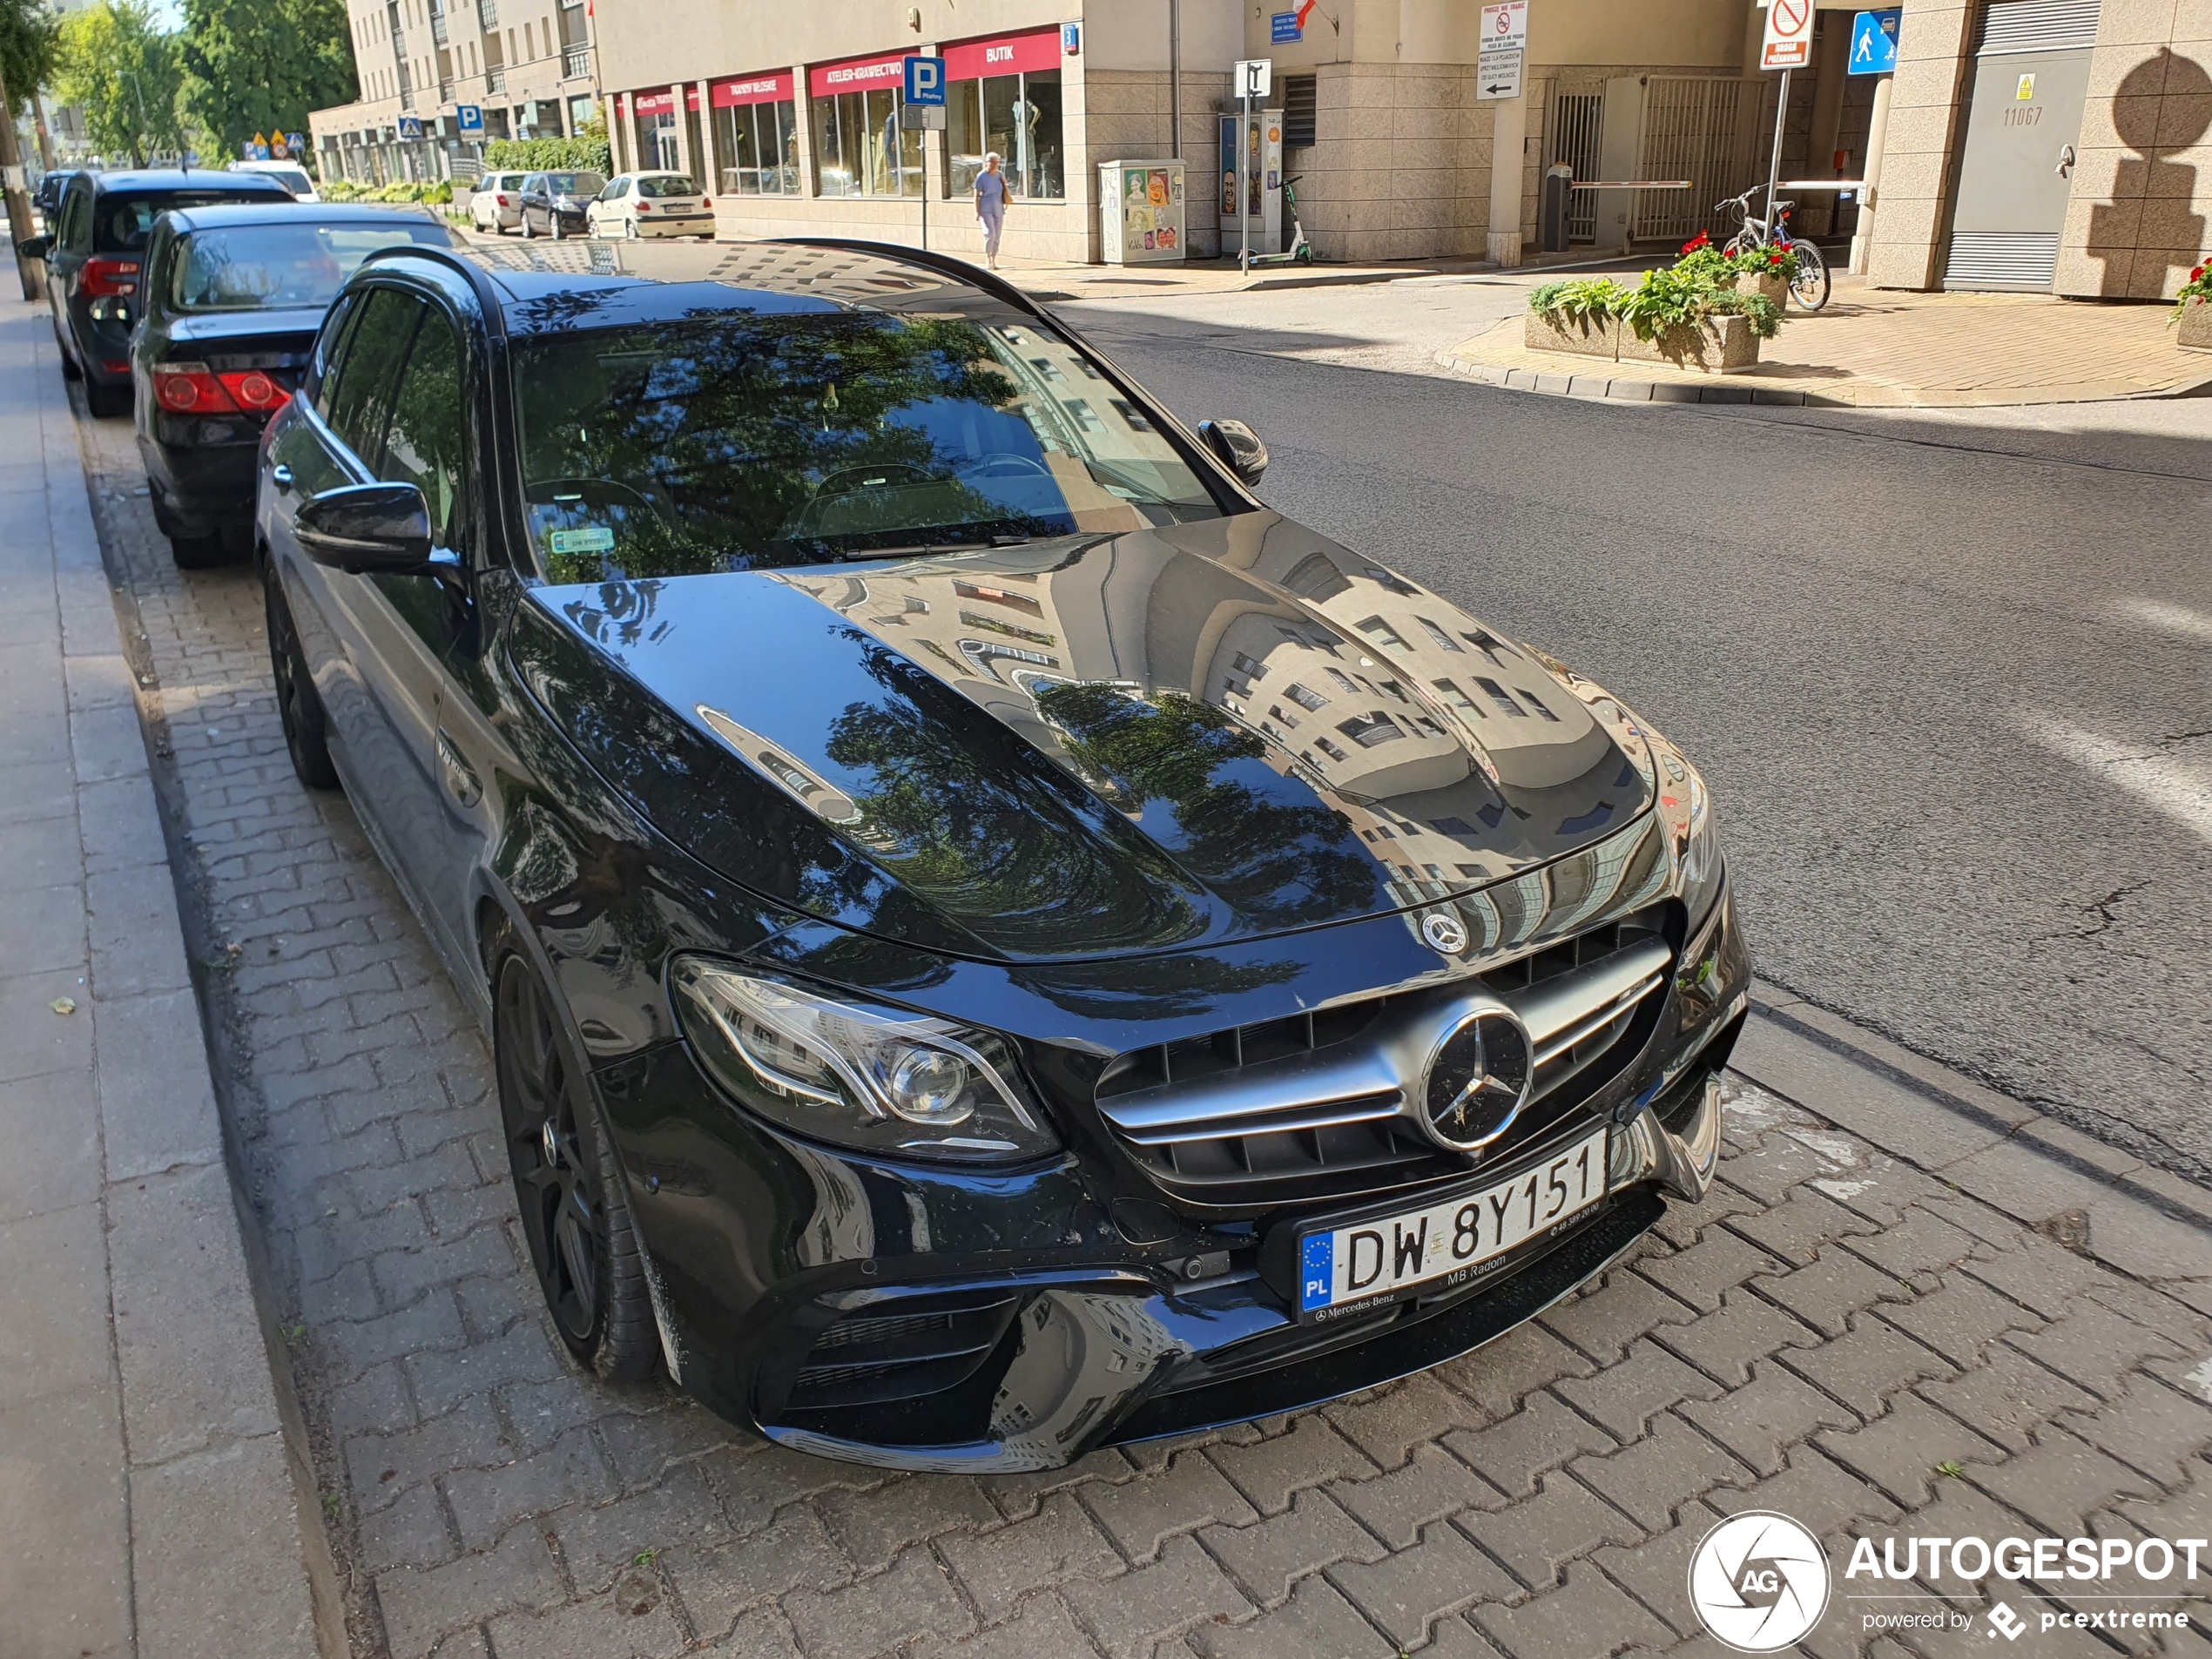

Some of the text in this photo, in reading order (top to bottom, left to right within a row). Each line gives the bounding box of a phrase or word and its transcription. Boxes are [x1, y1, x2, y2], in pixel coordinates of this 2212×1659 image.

[1066, 30, 1071, 45] 3
[1775, 42, 1797, 52] DROGA
[986, 45, 1014, 63] BUTIK
[1767, 52, 1802, 64] POŻAROWA
[914, 62, 937, 99] P
[462, 107, 477, 127] P
[2004, 106, 2043, 126] 11067
[1347, 1144, 1589, 1291] DW 8Y151
[1558, 1203, 1599, 1231] 48 389 20 00
[1447, 1255, 1506, 1286] MB Radom
[1306, 1279, 1327, 1298] PL
[1328, 1293, 1394, 1318] Mercedes-Benz
